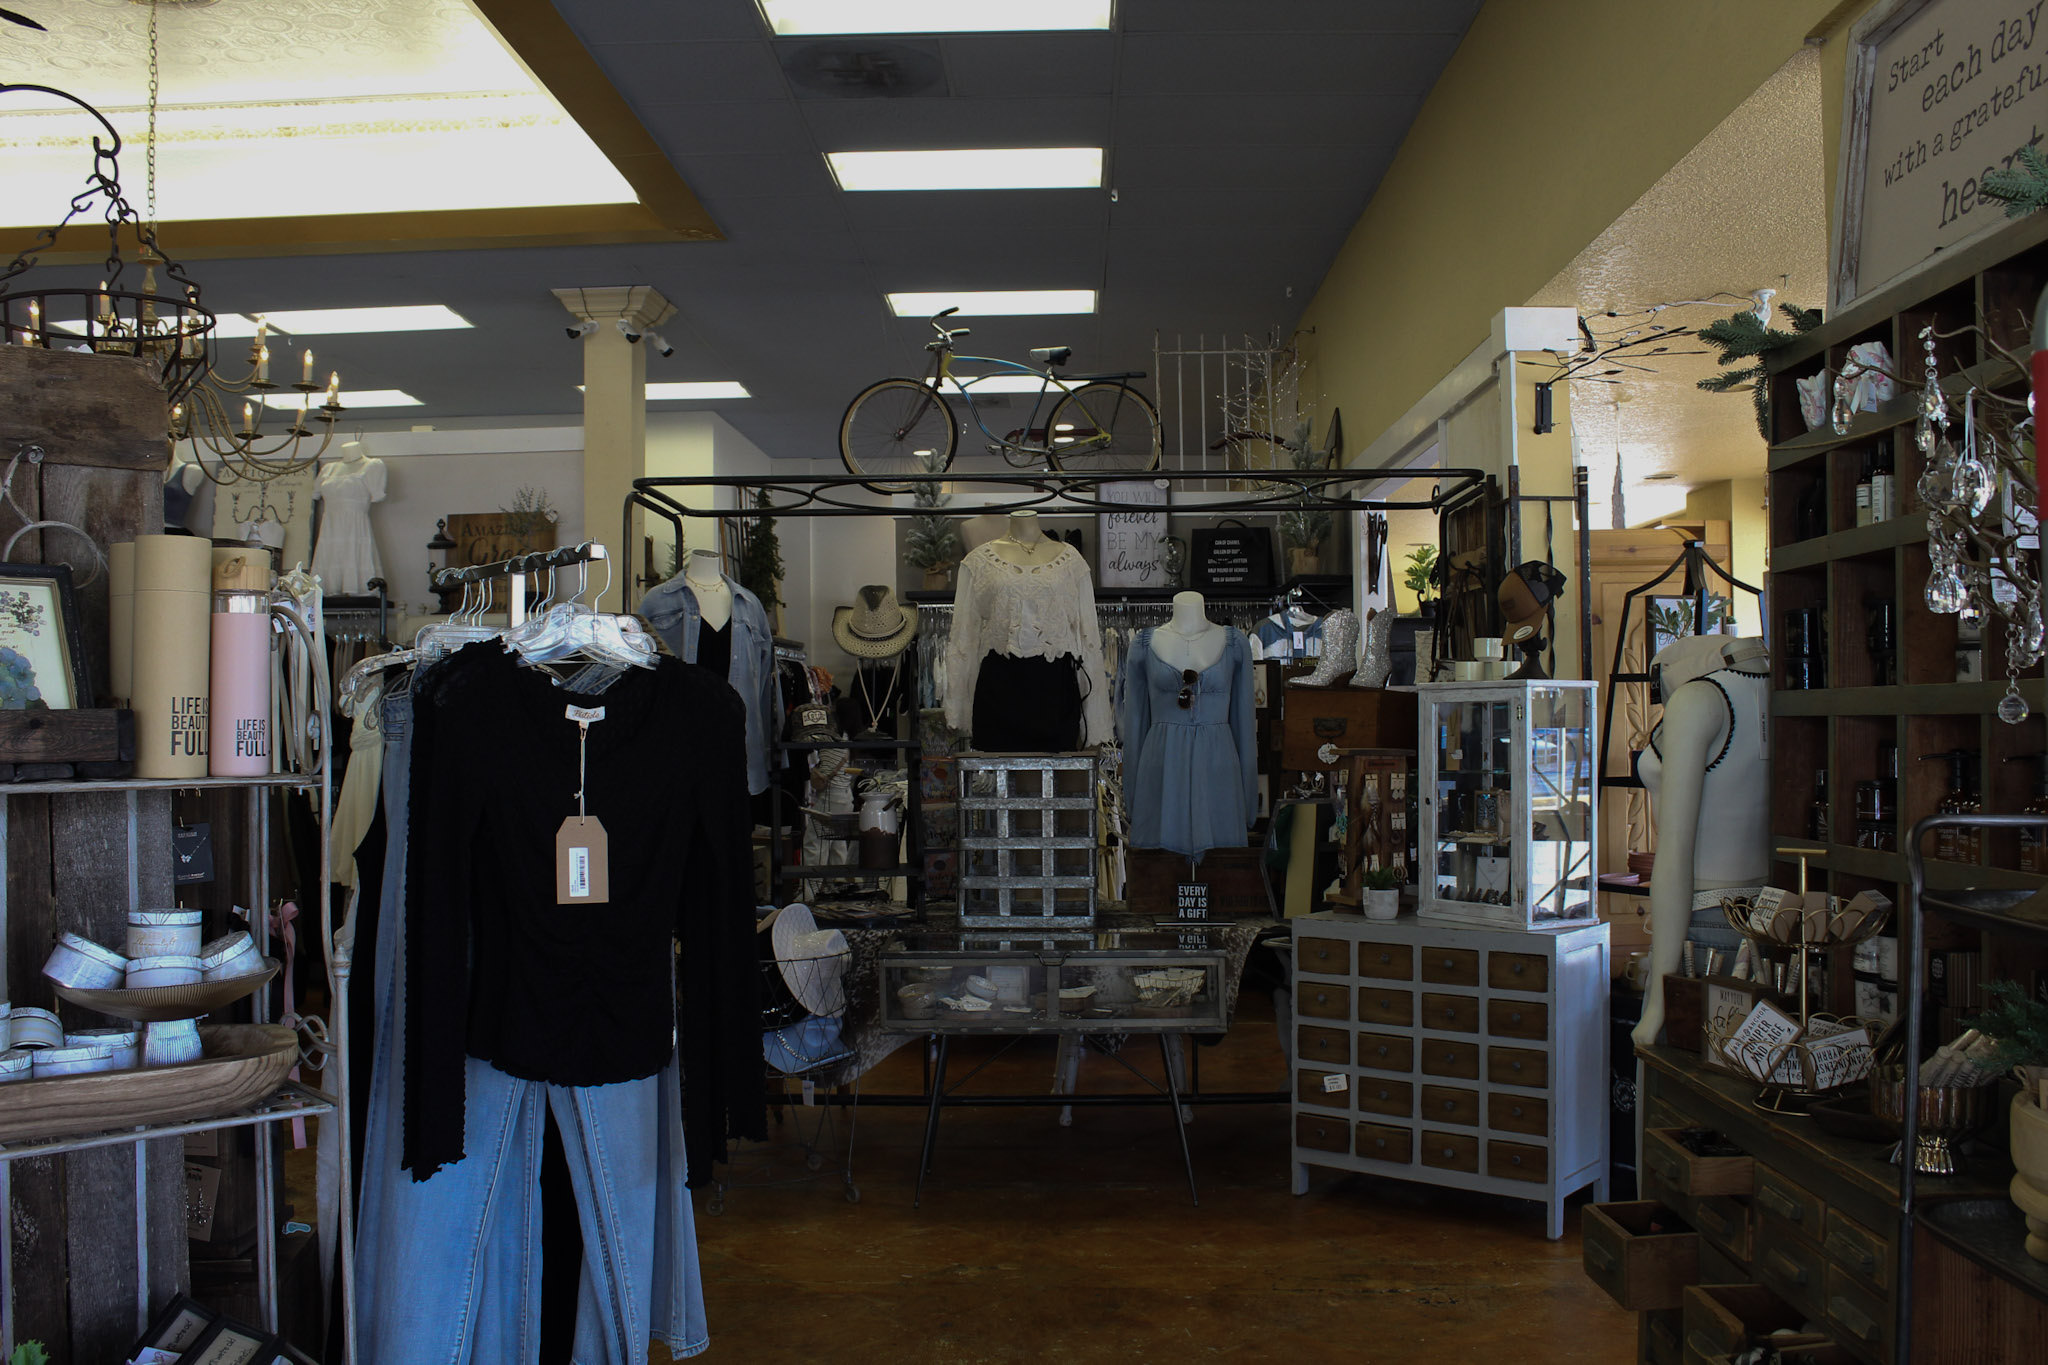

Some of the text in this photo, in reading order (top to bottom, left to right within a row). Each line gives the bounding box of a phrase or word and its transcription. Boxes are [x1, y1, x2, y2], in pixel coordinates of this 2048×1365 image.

[1888, 28, 1944, 93] Start
[1922, 0, 2044, 112] each day
[1884, 140, 1927, 188] with
[1932, 133, 1944, 157] a
[1106, 491, 1160, 504] YOU WILL
[1107, 511, 1159, 530] forever
[1107, 532, 1161, 550] BE MY
[1108, 551, 1160, 582] always
[171, 697, 201, 714] LIFE
[236, 719, 266, 731] LIFE IS
[236, 731, 266, 740] BEAUTY
[236, 741, 267, 757] FULL
[1178, 886, 1207, 896] EVERY
[1178, 897, 1208, 907] DAY IS
[1178, 908, 1207, 919] A GIFT
[1744, 1019, 1773, 1054] JUNIPER
[1750, 1045, 1768, 1064] AND
